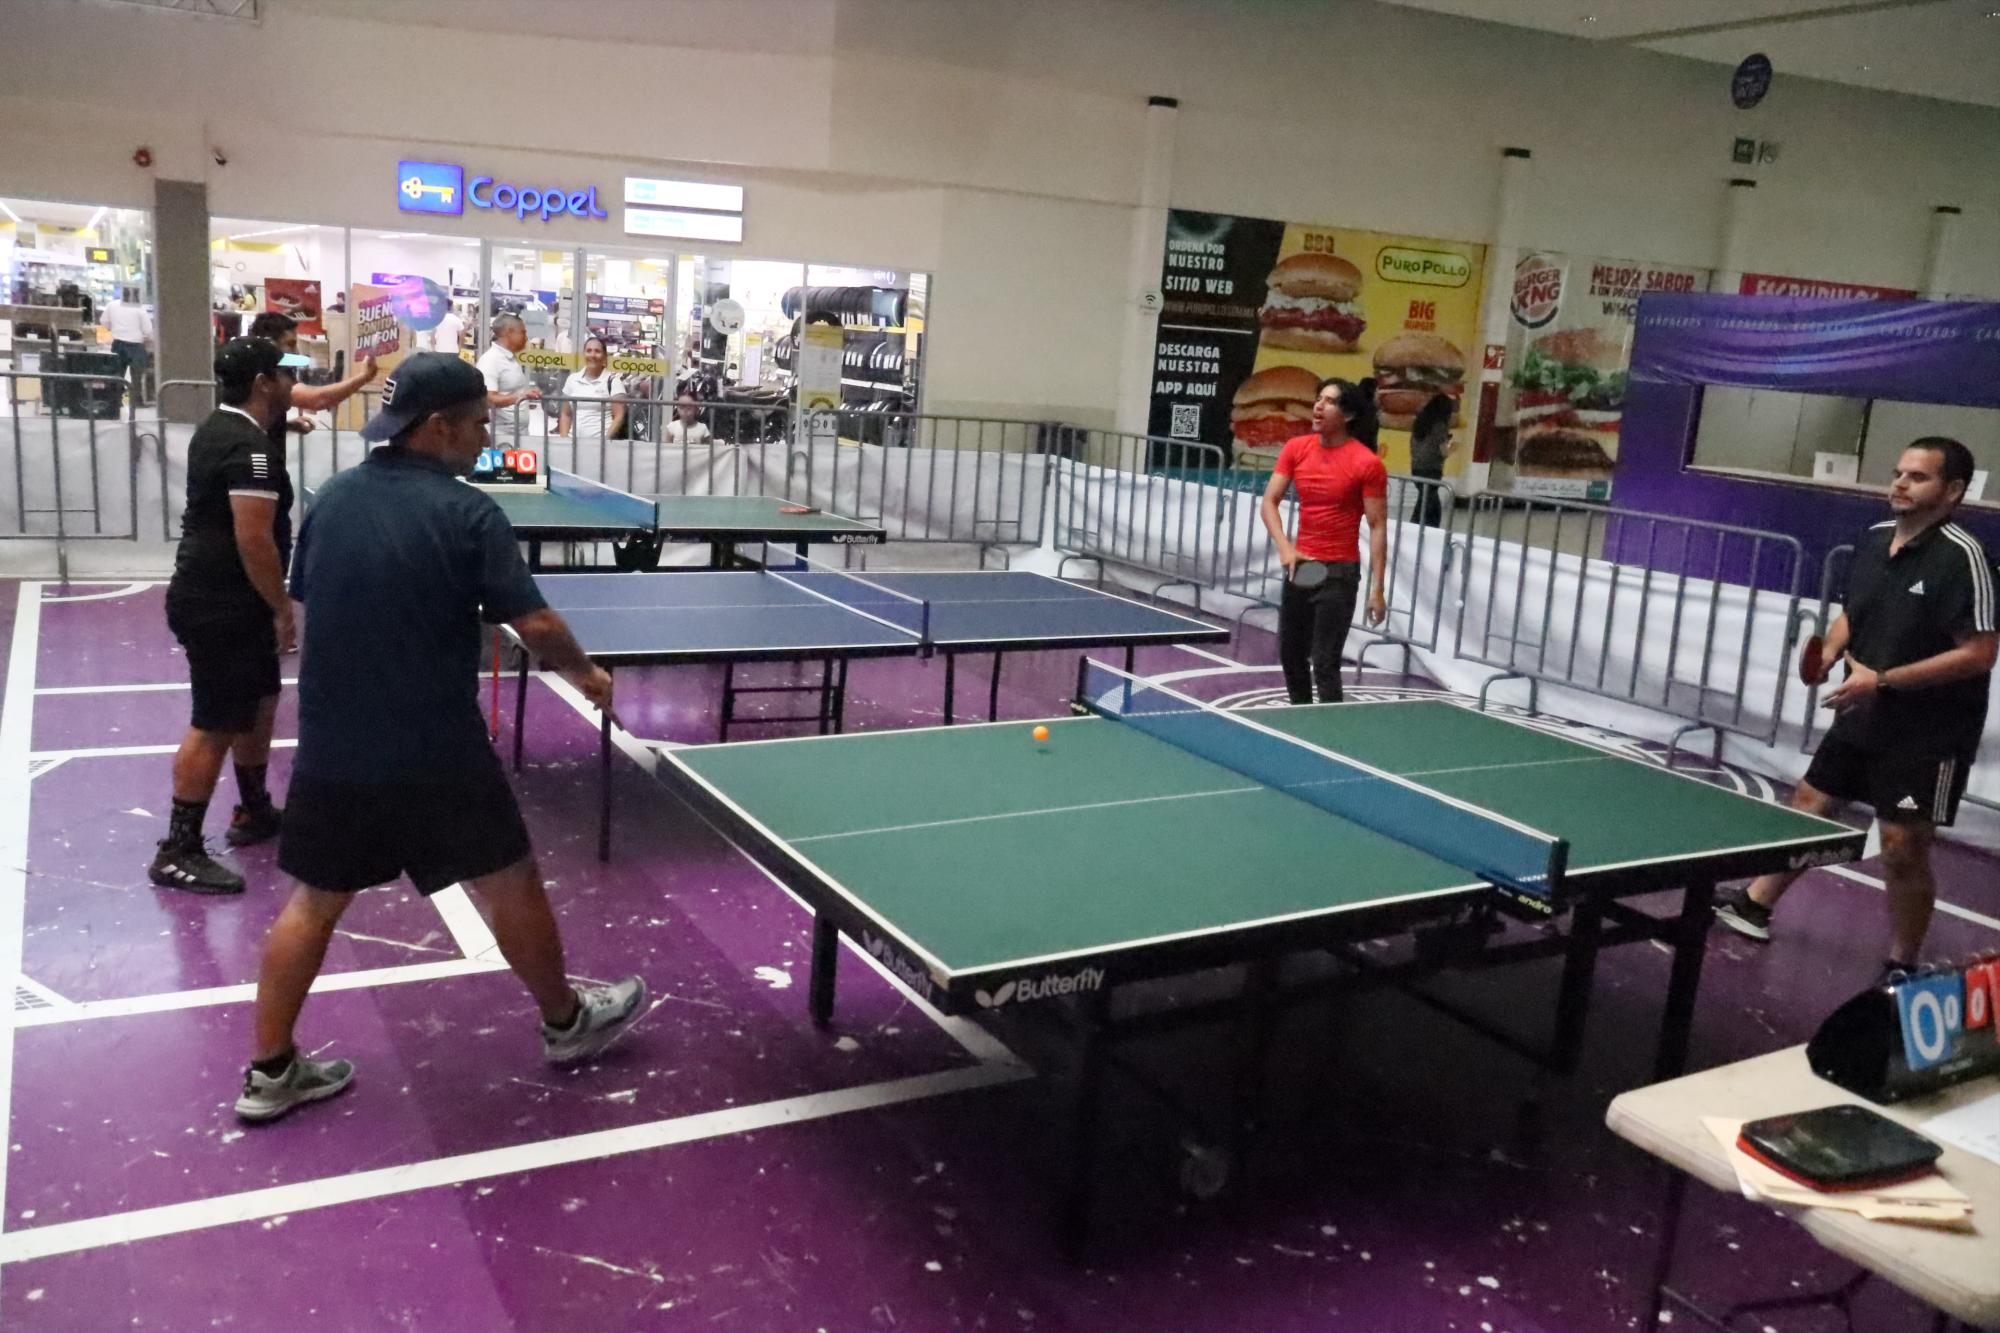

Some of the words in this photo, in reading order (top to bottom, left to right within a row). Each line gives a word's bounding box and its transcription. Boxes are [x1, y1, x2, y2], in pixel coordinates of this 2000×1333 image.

[468, 176, 608, 221] Coppel
[1168, 239, 1205, 254] ORDENA
[1207, 242, 1225, 255] POR
[1168, 254, 1225, 271] NUESTRO
[1165, 275, 1200, 293] SITIO
[1206, 278, 1234, 295] WEB
[1515, 268, 1561, 294] BURGER
[1592, 265, 1642, 288] MEJOR
[1646, 270, 1695, 294] SABOR
[1517, 282, 1562, 309] KNG
[358, 301, 395, 324] BUEN
[1408, 300, 1435, 320] BIG
[518, 352, 567, 367] Coppel
[1158, 343, 1220, 358] DESCARGA
[612, 359, 661, 374] Coppel
[1158, 359, 1219, 373] NUESTRA
[1156, 381, 1183, 394] APP
[1186, 381, 1217, 396] AQUÍ
[1518, 894, 1552, 914] andro
[882, 946, 933, 1000] Butterfly
[1016, 967, 1105, 1002] Butterfly
[1910, 990, 1945, 1060] 0
